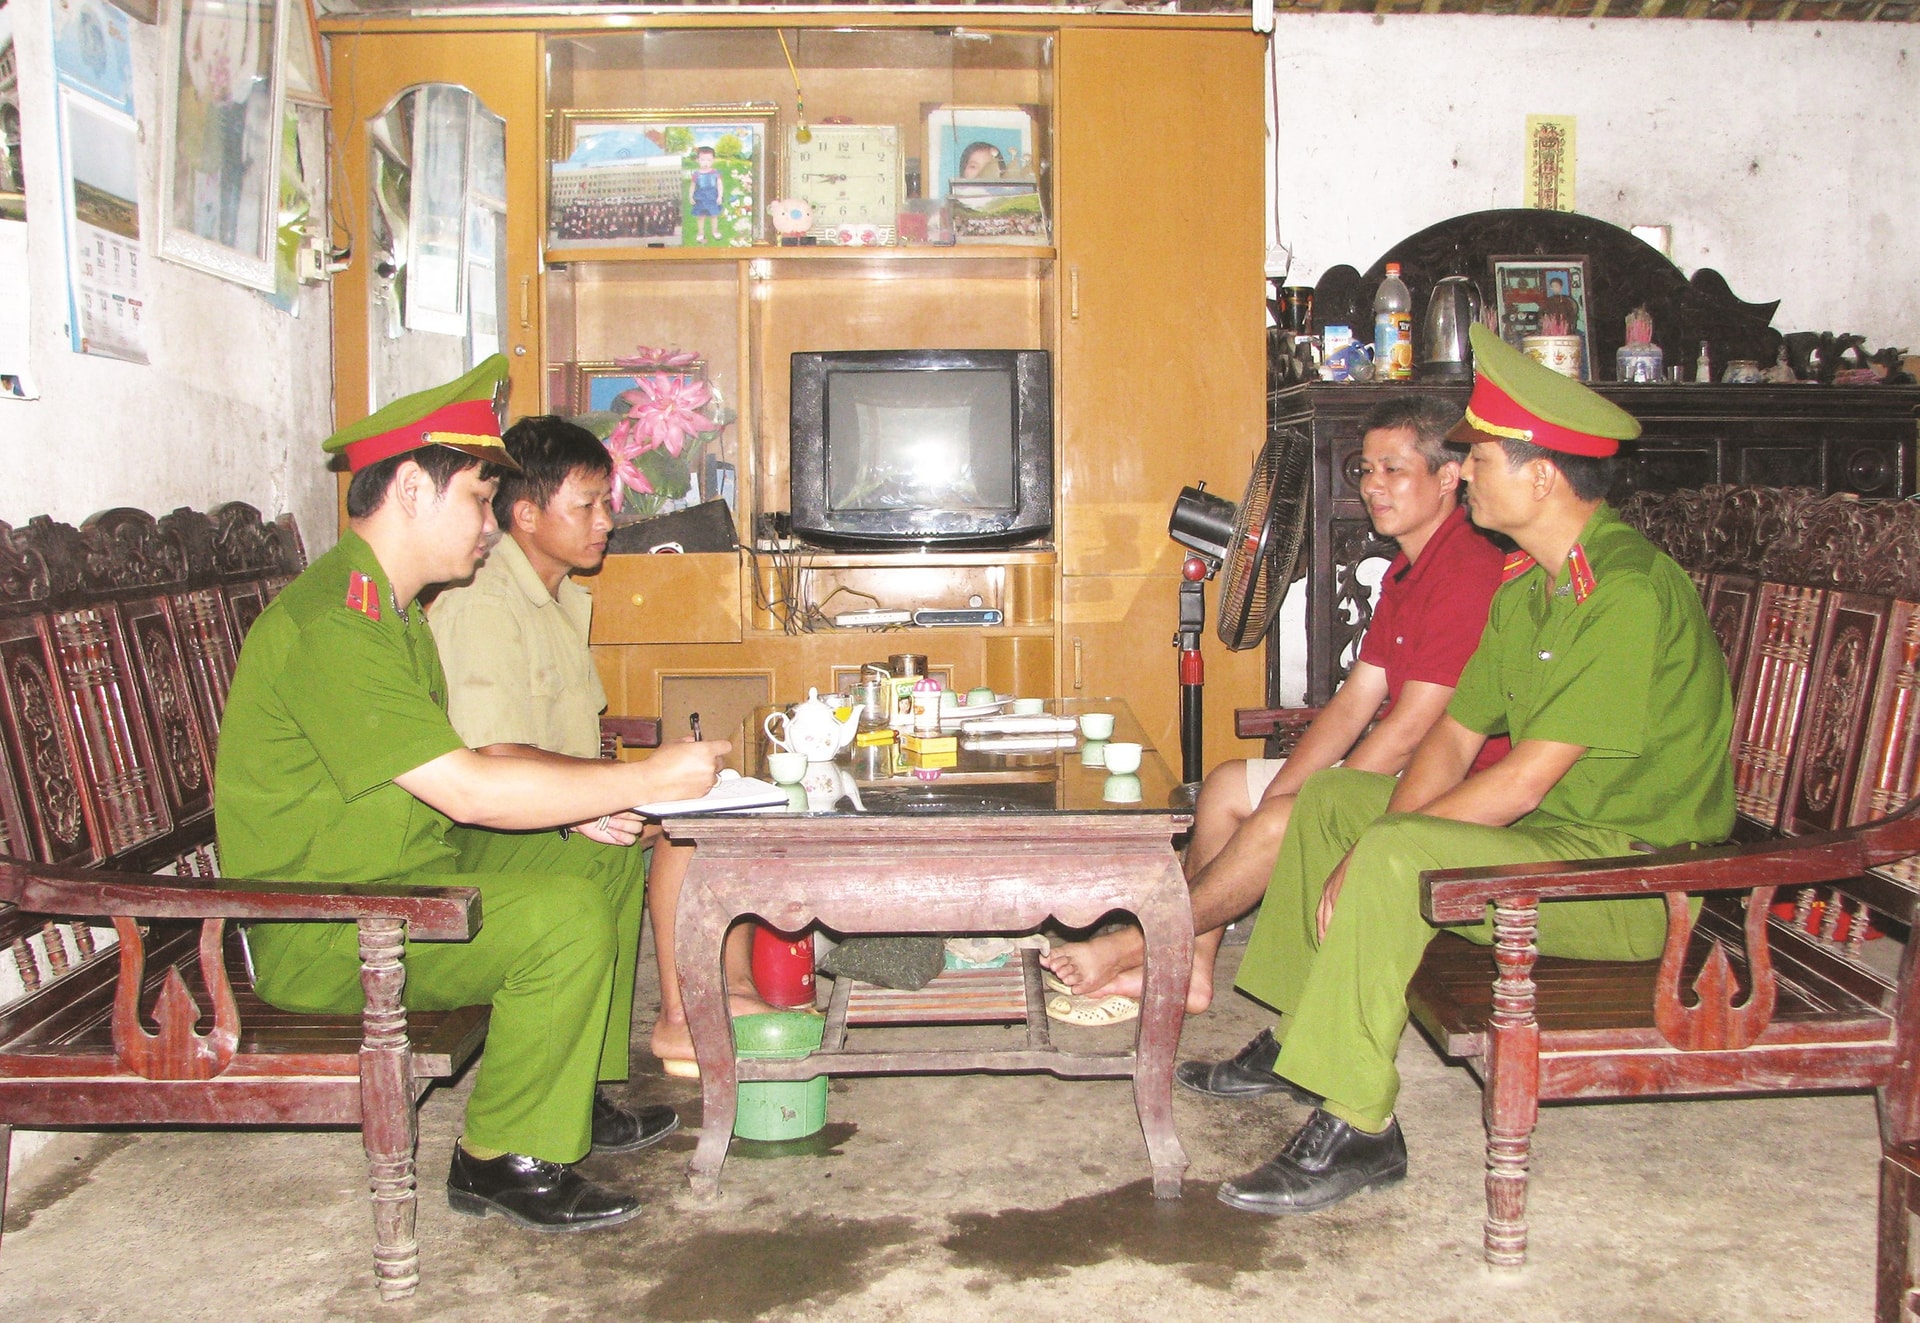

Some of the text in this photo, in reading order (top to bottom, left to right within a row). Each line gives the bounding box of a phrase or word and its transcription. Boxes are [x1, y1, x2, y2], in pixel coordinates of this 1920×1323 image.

[819, 142, 827, 151] 11
[838, 142, 849, 152] 12
[800, 152, 810, 161] 10
[878, 152, 885, 162] 2
[801, 174, 809, 183] 9
[878, 173, 885, 183] 3
[879, 195, 885, 205] 4
[820, 205, 826, 215] 7
[839, 206, 847, 215] 6
[860, 206, 867, 215] 5
